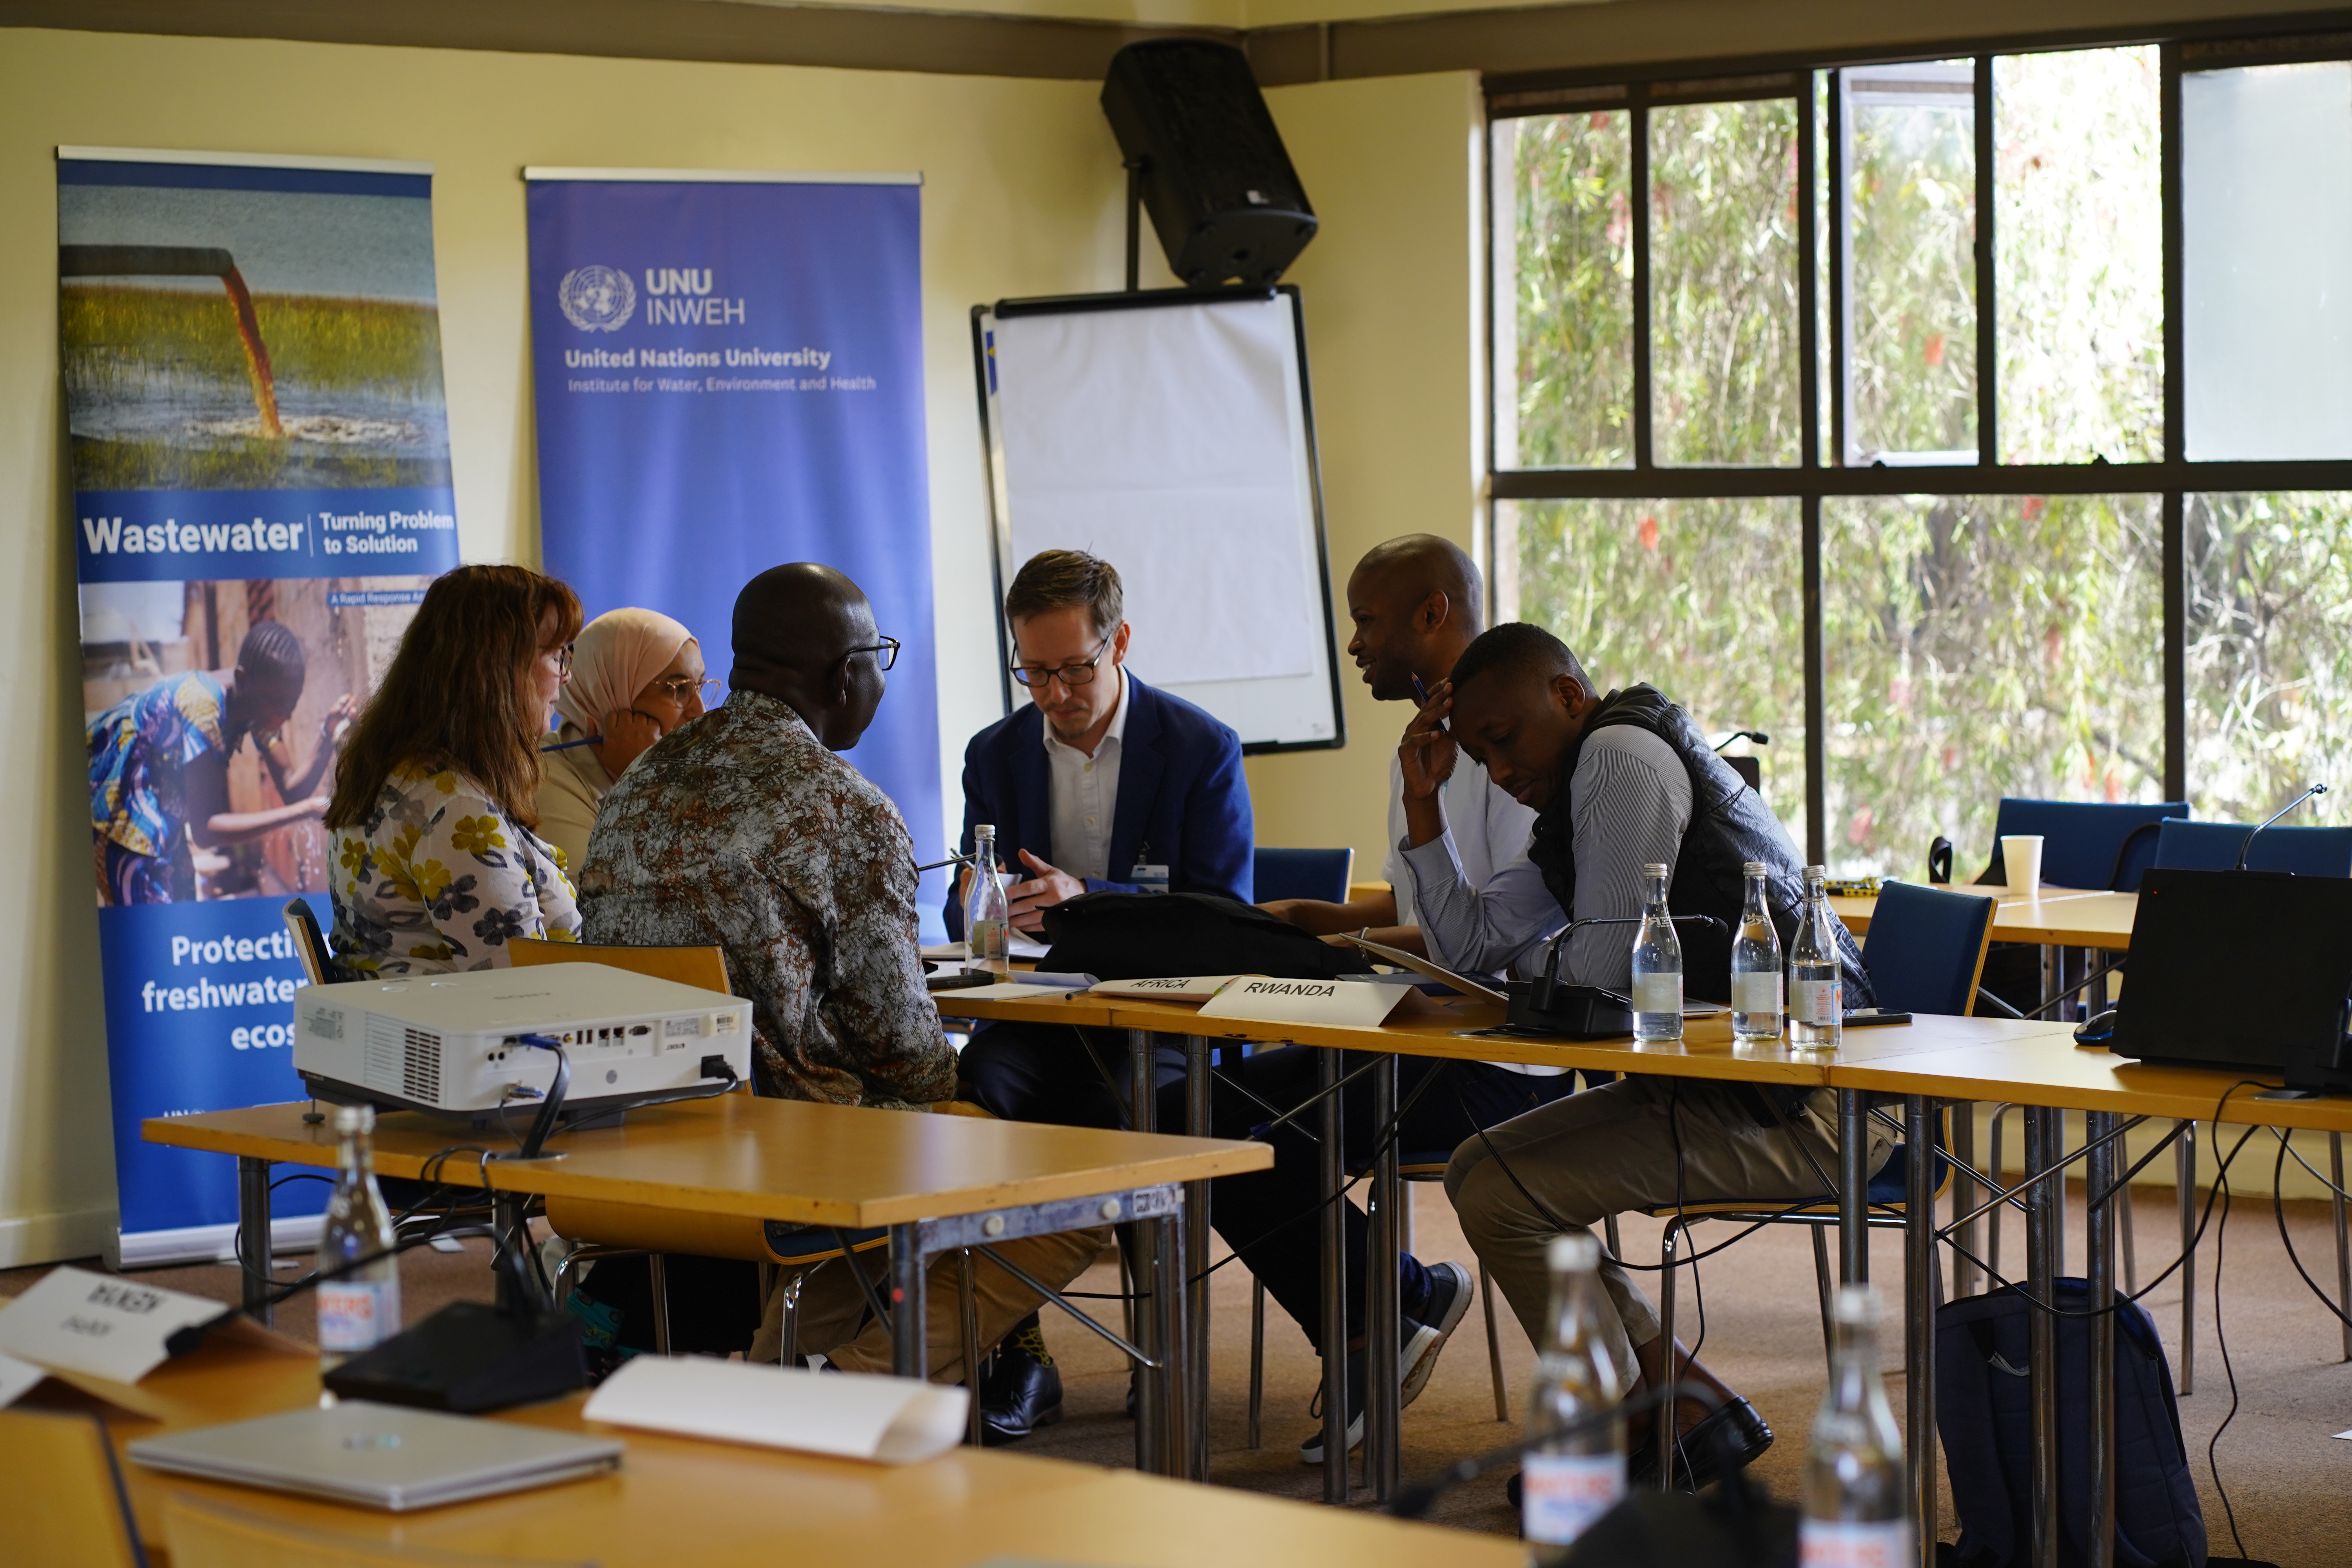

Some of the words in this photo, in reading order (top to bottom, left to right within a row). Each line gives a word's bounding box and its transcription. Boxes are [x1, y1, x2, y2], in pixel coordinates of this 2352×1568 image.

[645, 268, 713, 296] UNU
[646, 298, 745, 325] INWEH
[564, 348, 635, 368] United
[640, 347, 721, 368] Nations
[725, 347, 831, 371] University
[568, 377, 630, 392] Institute
[633, 376, 654, 392] for
[657, 377, 703, 394] Water,
[706, 376, 796, 392] Environment
[799, 376, 826, 391] and
[829, 375, 877, 390] Health
[319, 510, 387, 534] Turning
[389, 510, 455, 529] Problem
[83, 516, 304, 555] Wastewater
[323, 536, 342, 555] to
[345, 534, 418, 554] Solution
[331, 594, 339, 605] A
[339, 592, 366, 605] Rapid
[367, 592, 410, 604] Response
[171, 928, 336, 966] Protecti
[1131, 979, 1191, 989] AFRICA
[1244, 982, 1336, 997] RWANDA
